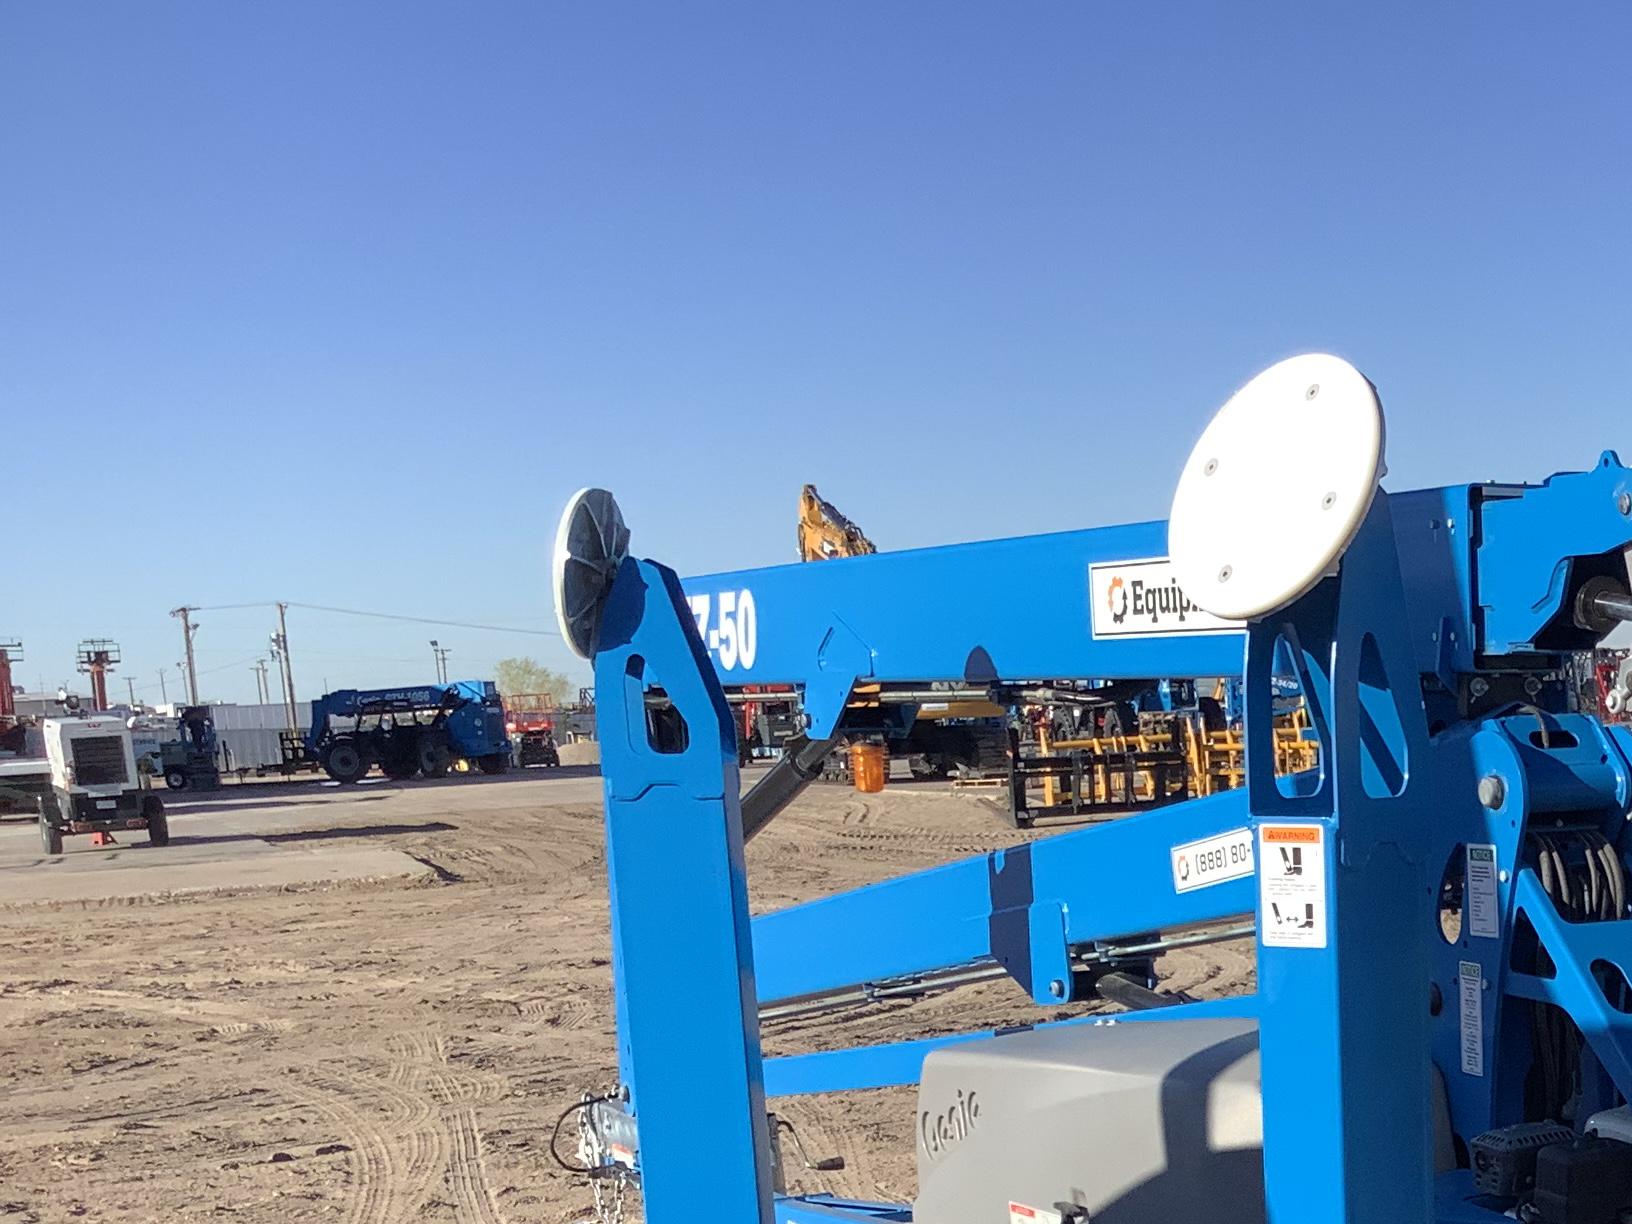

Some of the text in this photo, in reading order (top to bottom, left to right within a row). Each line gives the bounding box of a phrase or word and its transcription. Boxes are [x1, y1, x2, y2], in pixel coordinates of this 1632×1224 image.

[1131, 577, 1204, 623] Equip
[686, 588, 757, 671] Z-50
[1275, 831, 1315, 841] WARNING
